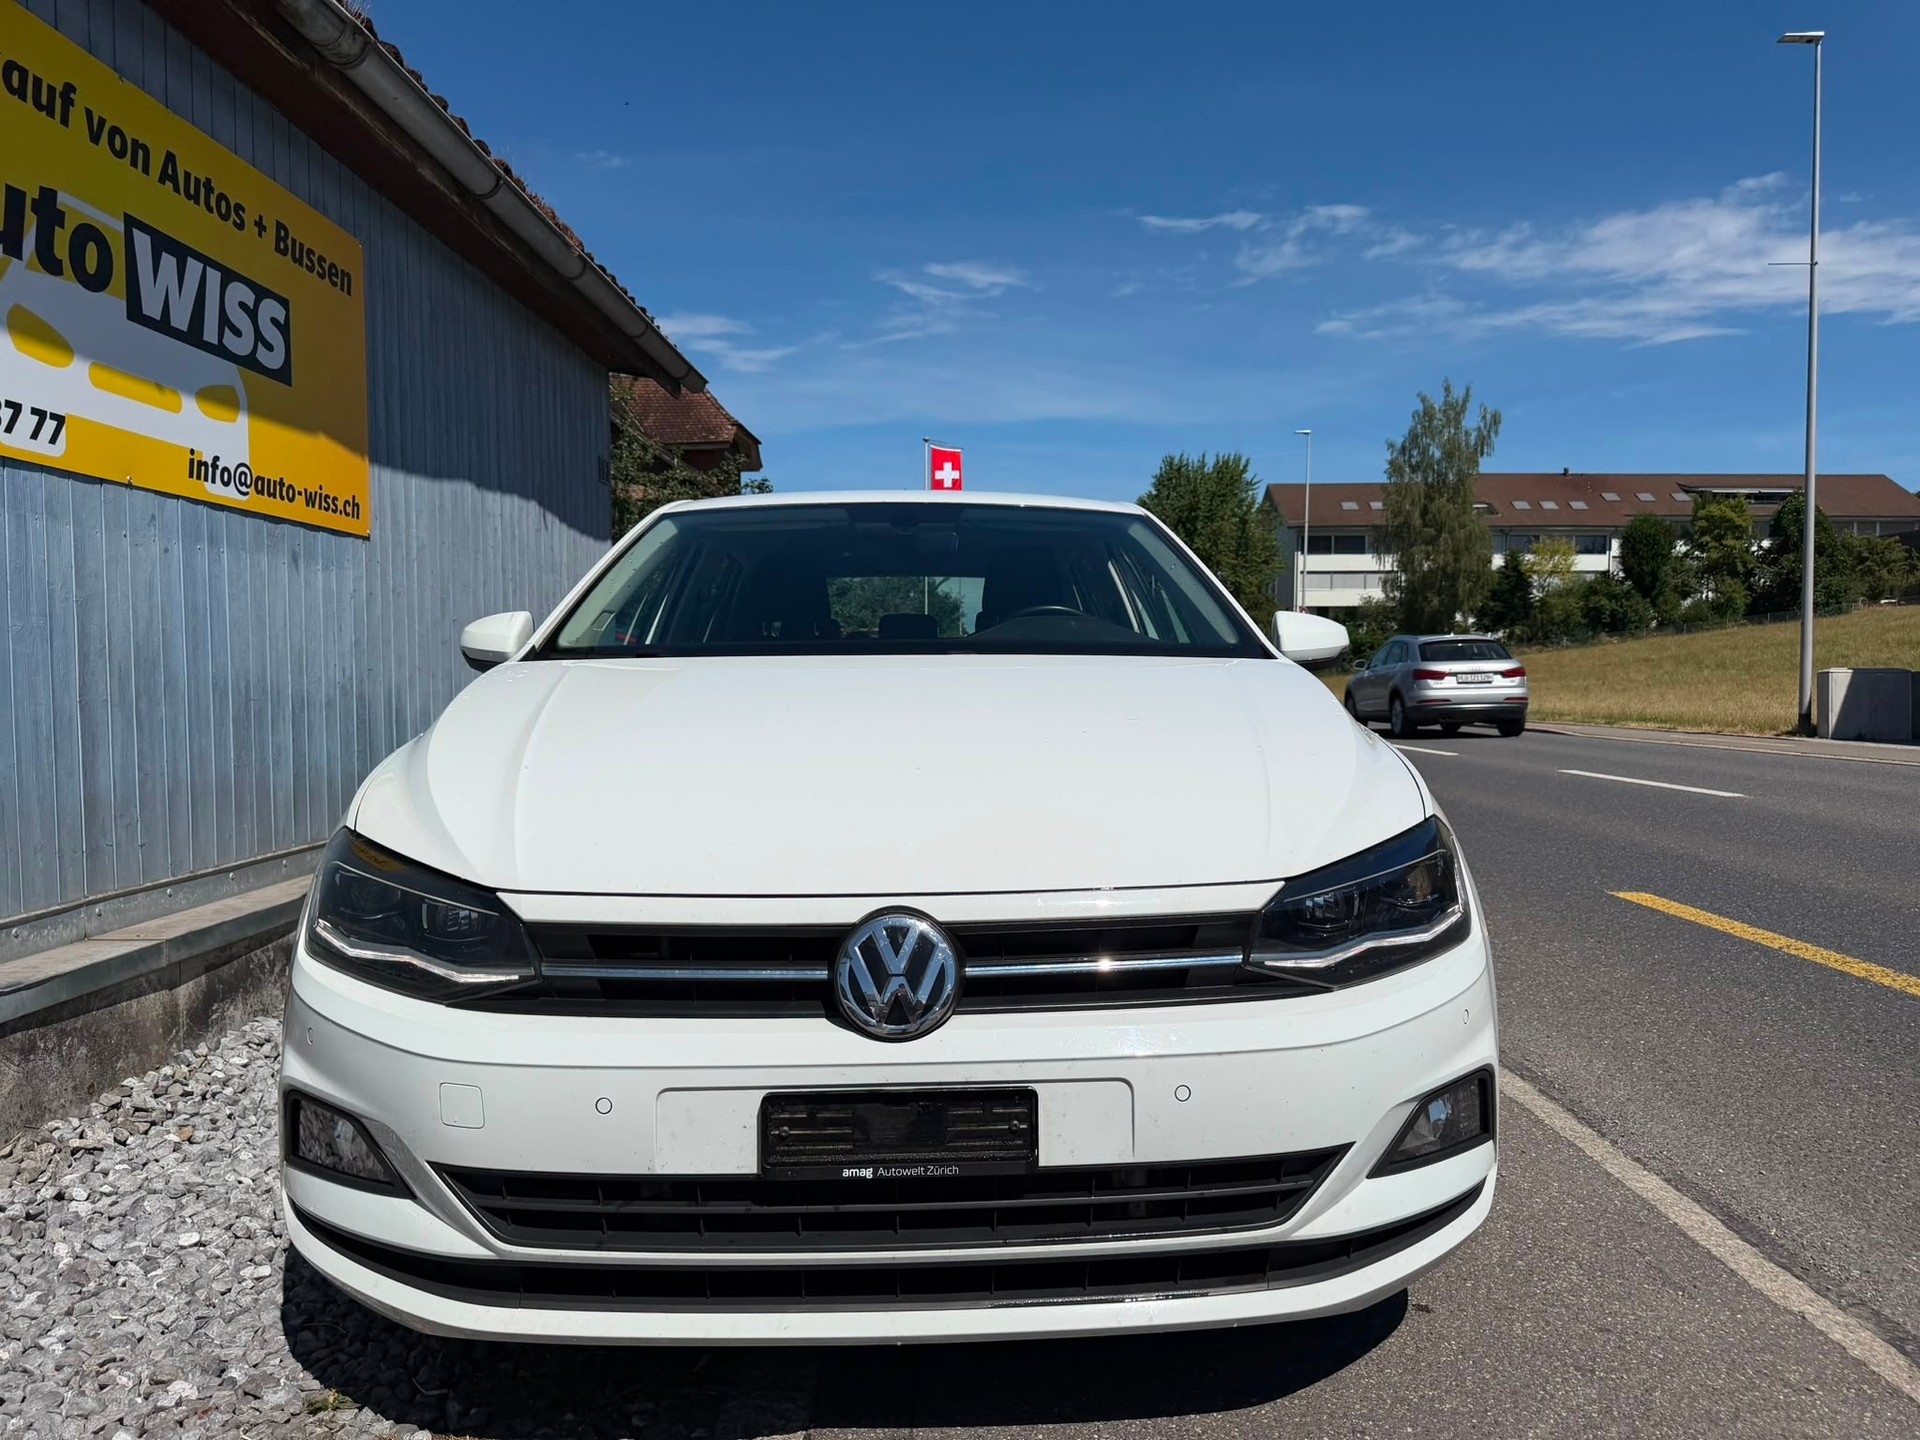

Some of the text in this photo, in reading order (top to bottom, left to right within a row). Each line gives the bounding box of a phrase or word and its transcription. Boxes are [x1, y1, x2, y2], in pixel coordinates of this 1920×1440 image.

[0, 57, 352, 297] auf von Autos + Bussen
[132, 227, 287, 370] WISS
[0, 398, 66, 446] 7 77
[187, 448, 361, 520] info@auto-wiss.ch
[842, 1165, 959, 1179] amag Autowelt Zürich
